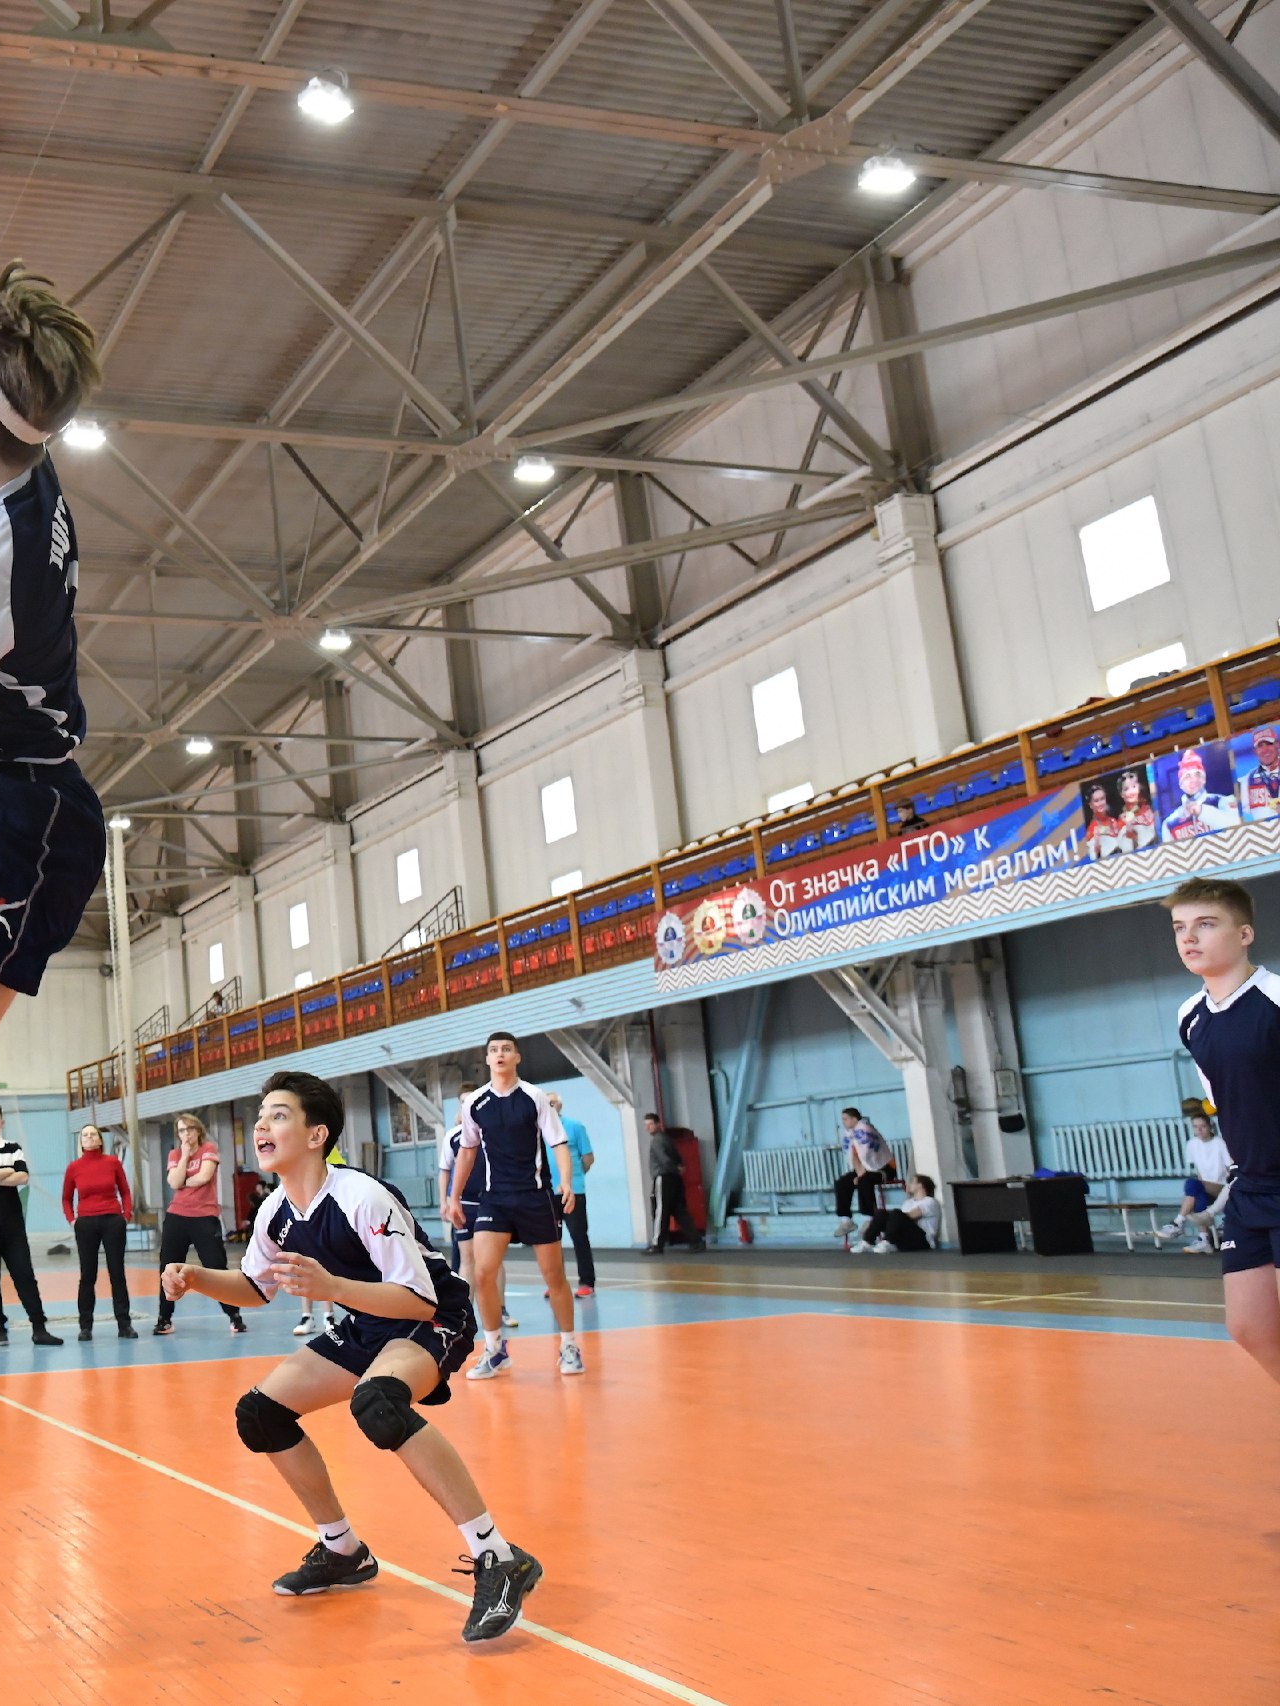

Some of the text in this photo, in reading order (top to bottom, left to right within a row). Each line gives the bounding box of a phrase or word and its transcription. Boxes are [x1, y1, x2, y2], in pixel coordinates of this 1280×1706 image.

[770, 825, 991, 907] От значка «ГТО» к
[773, 828, 1079, 937] Олимпийским медалям!
